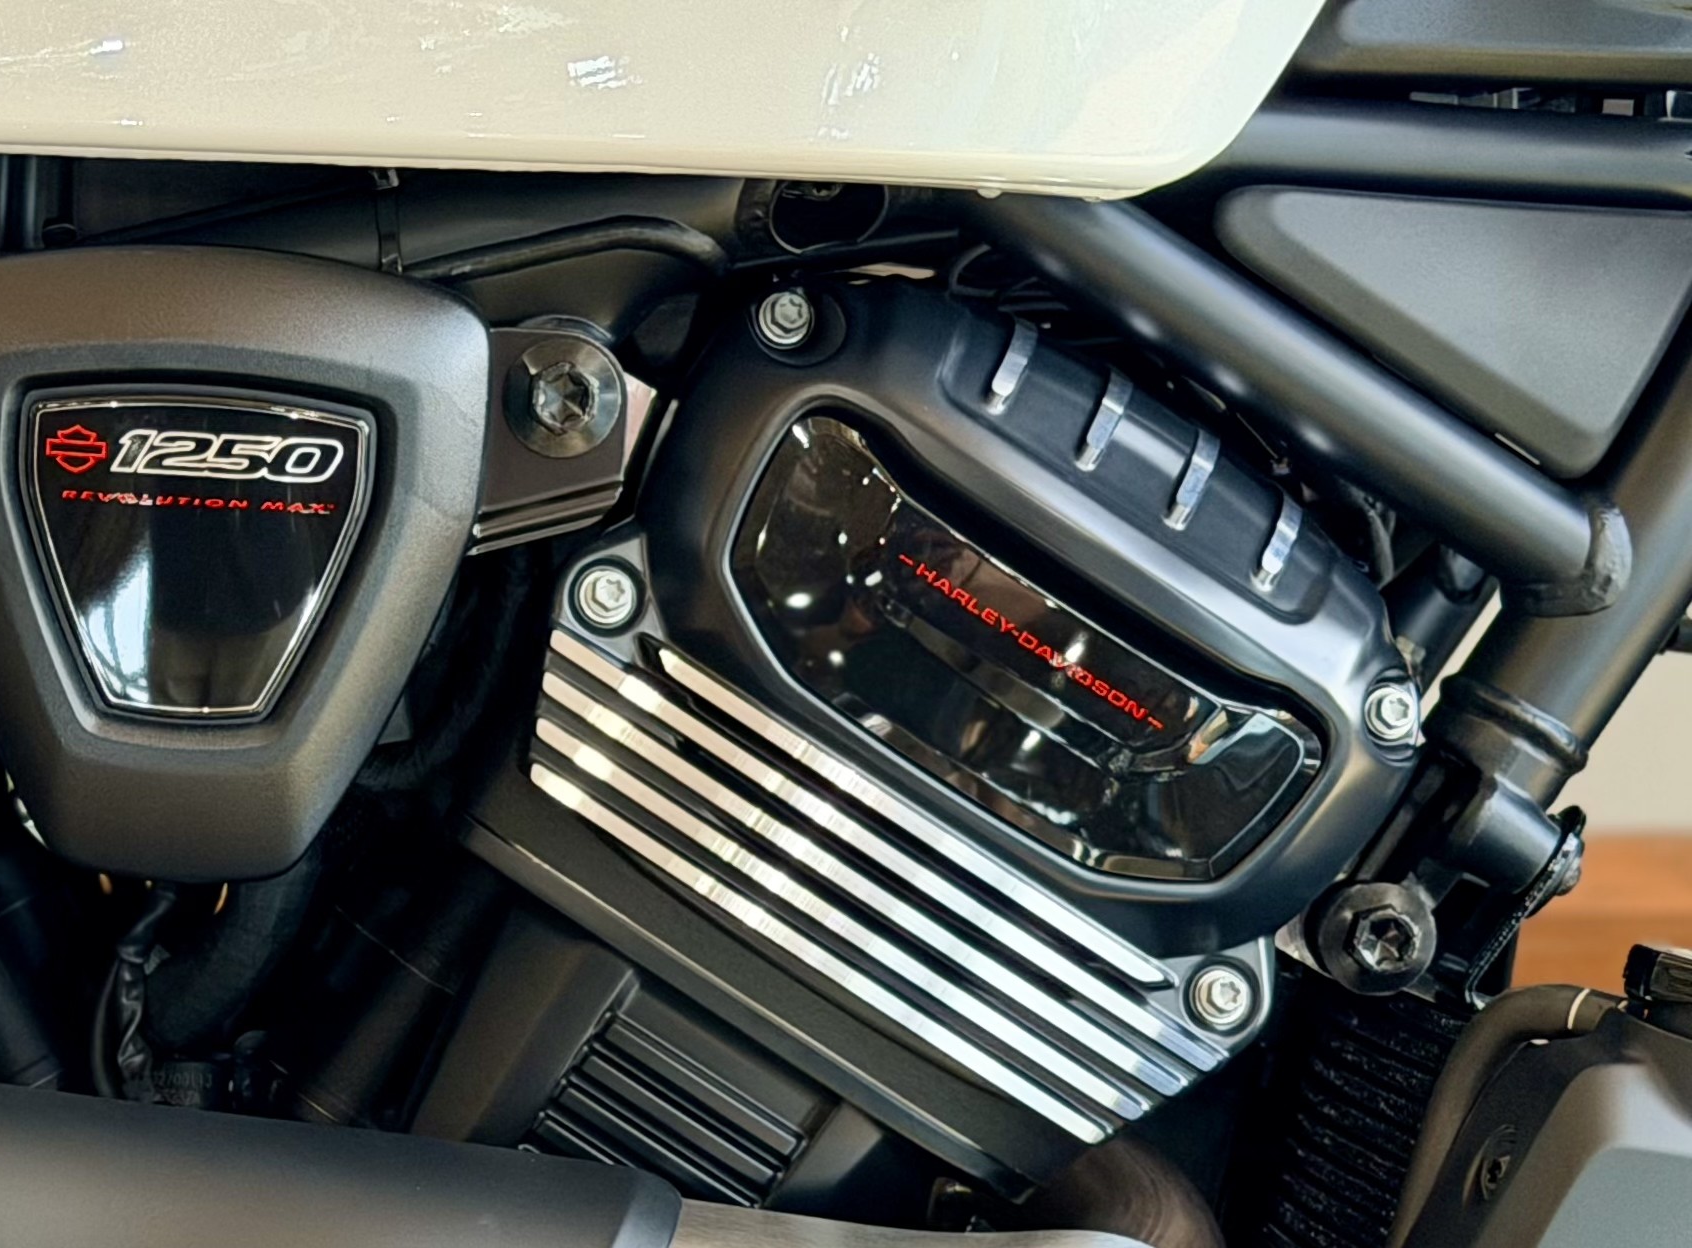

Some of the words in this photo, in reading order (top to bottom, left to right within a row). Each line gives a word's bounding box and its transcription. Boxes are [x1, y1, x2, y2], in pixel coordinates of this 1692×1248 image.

[109, 428, 344, 484] 1250
[61, 489, 249, 509] REVOLUTION
[915, 562, 1150, 721] HARLEY-DAVIDSON
